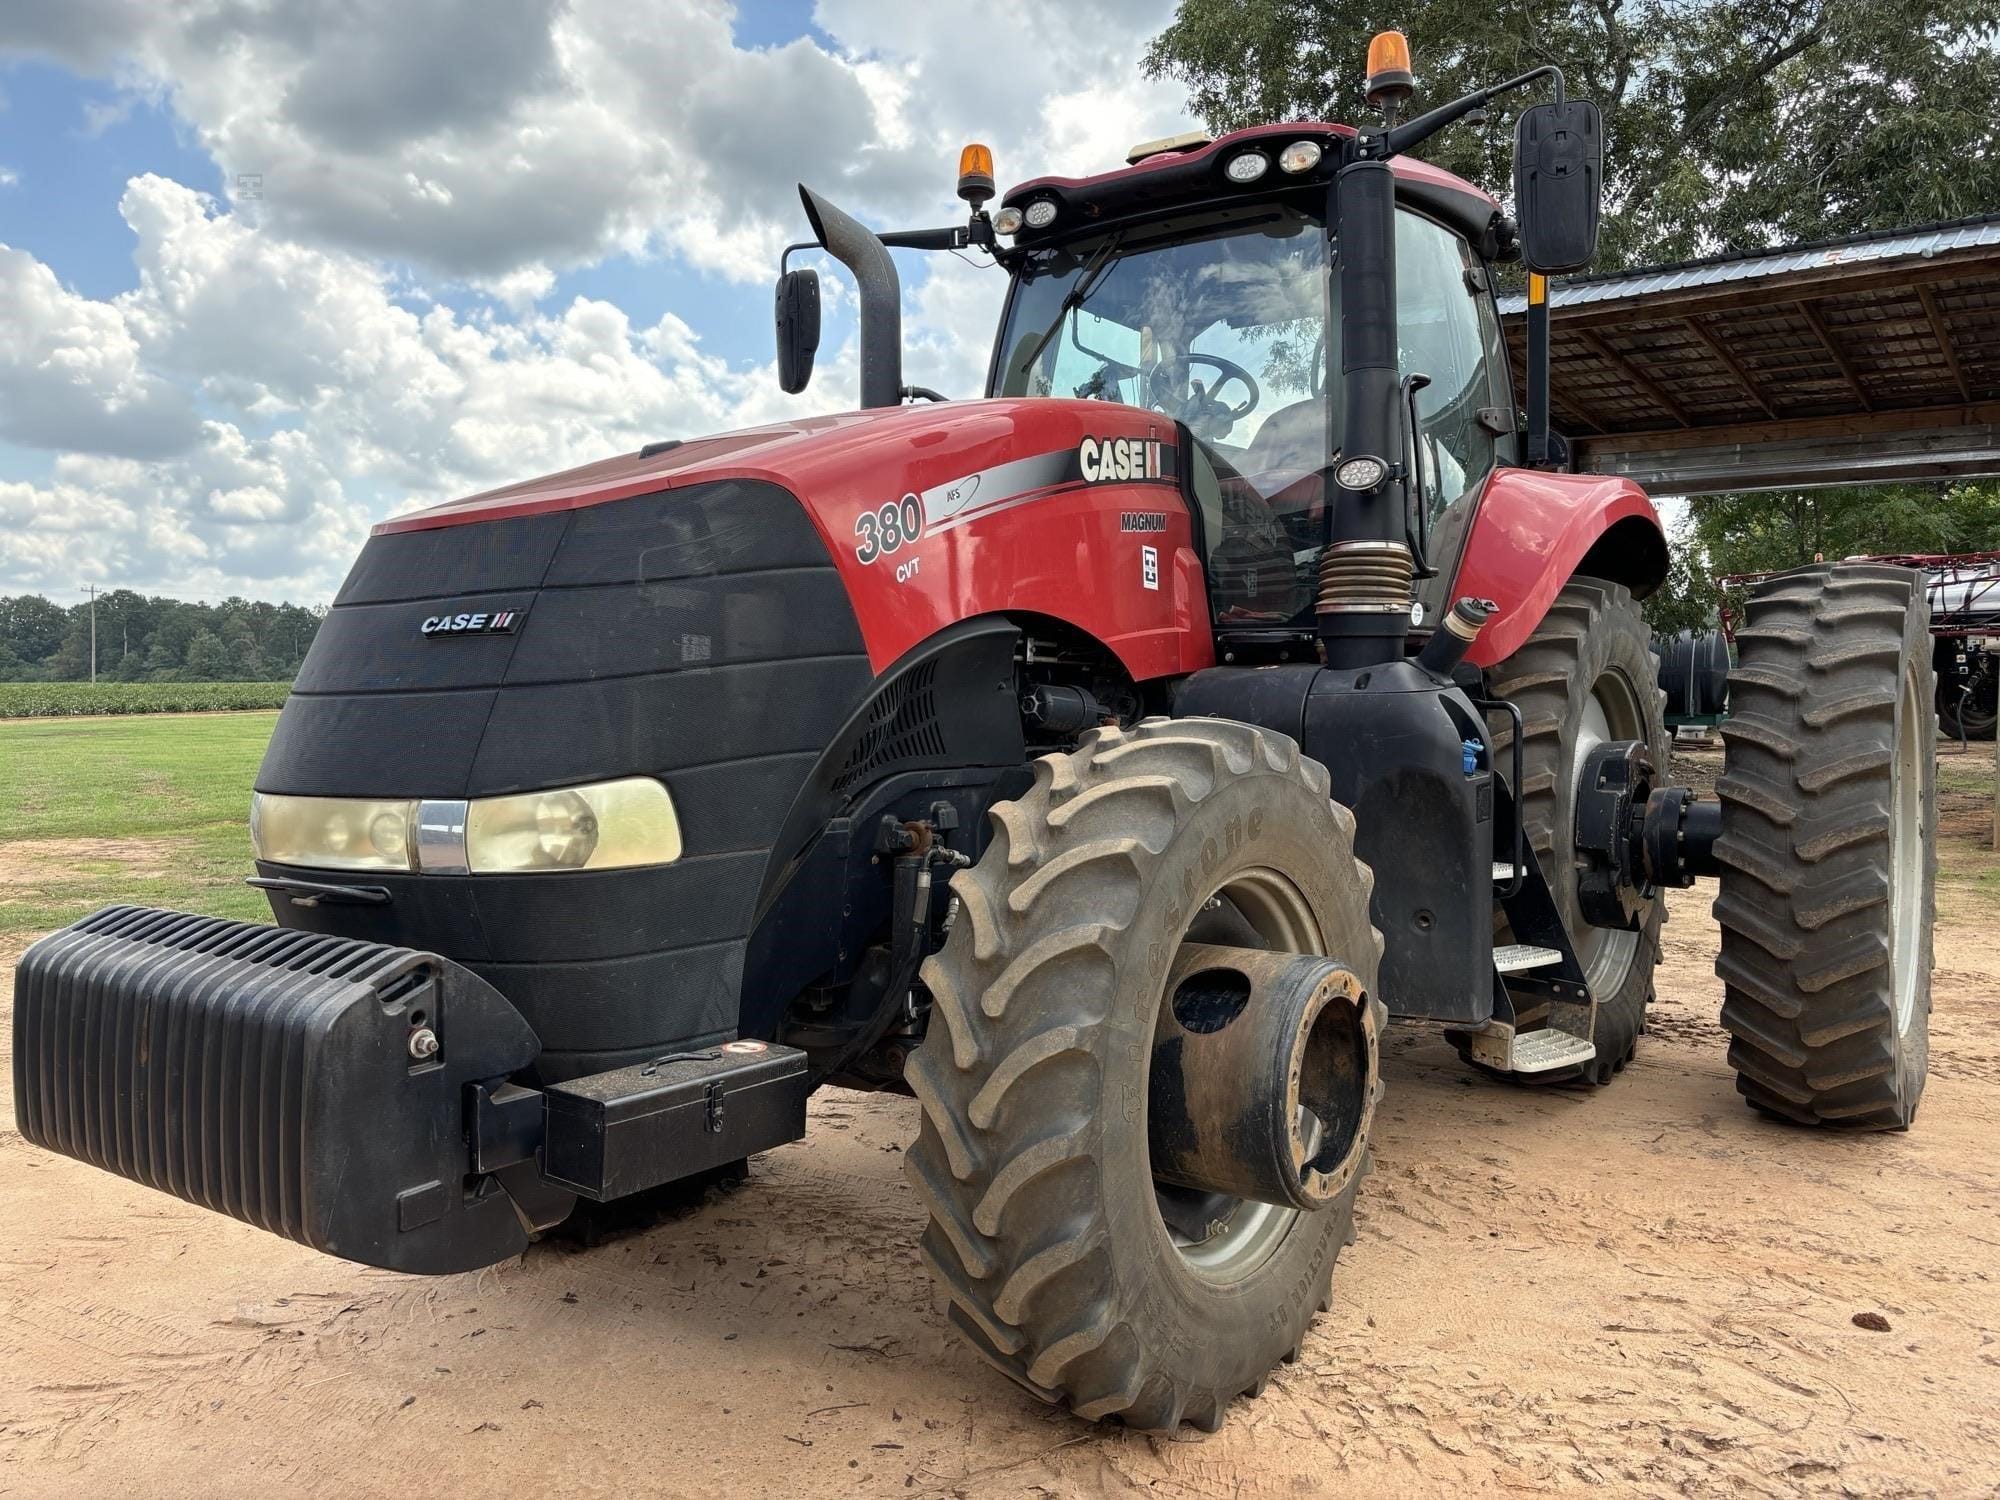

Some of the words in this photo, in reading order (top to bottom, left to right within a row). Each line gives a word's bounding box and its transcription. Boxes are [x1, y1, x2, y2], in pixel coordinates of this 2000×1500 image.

[1080, 438, 1143, 482] CASE
[946, 488, 961, 502] AFS
[855, 493, 921, 565] 380
[1121, 512, 1166, 532] MAGNUM
[896, 557, 920, 583] CVT
[421, 614, 488, 633] CASE
